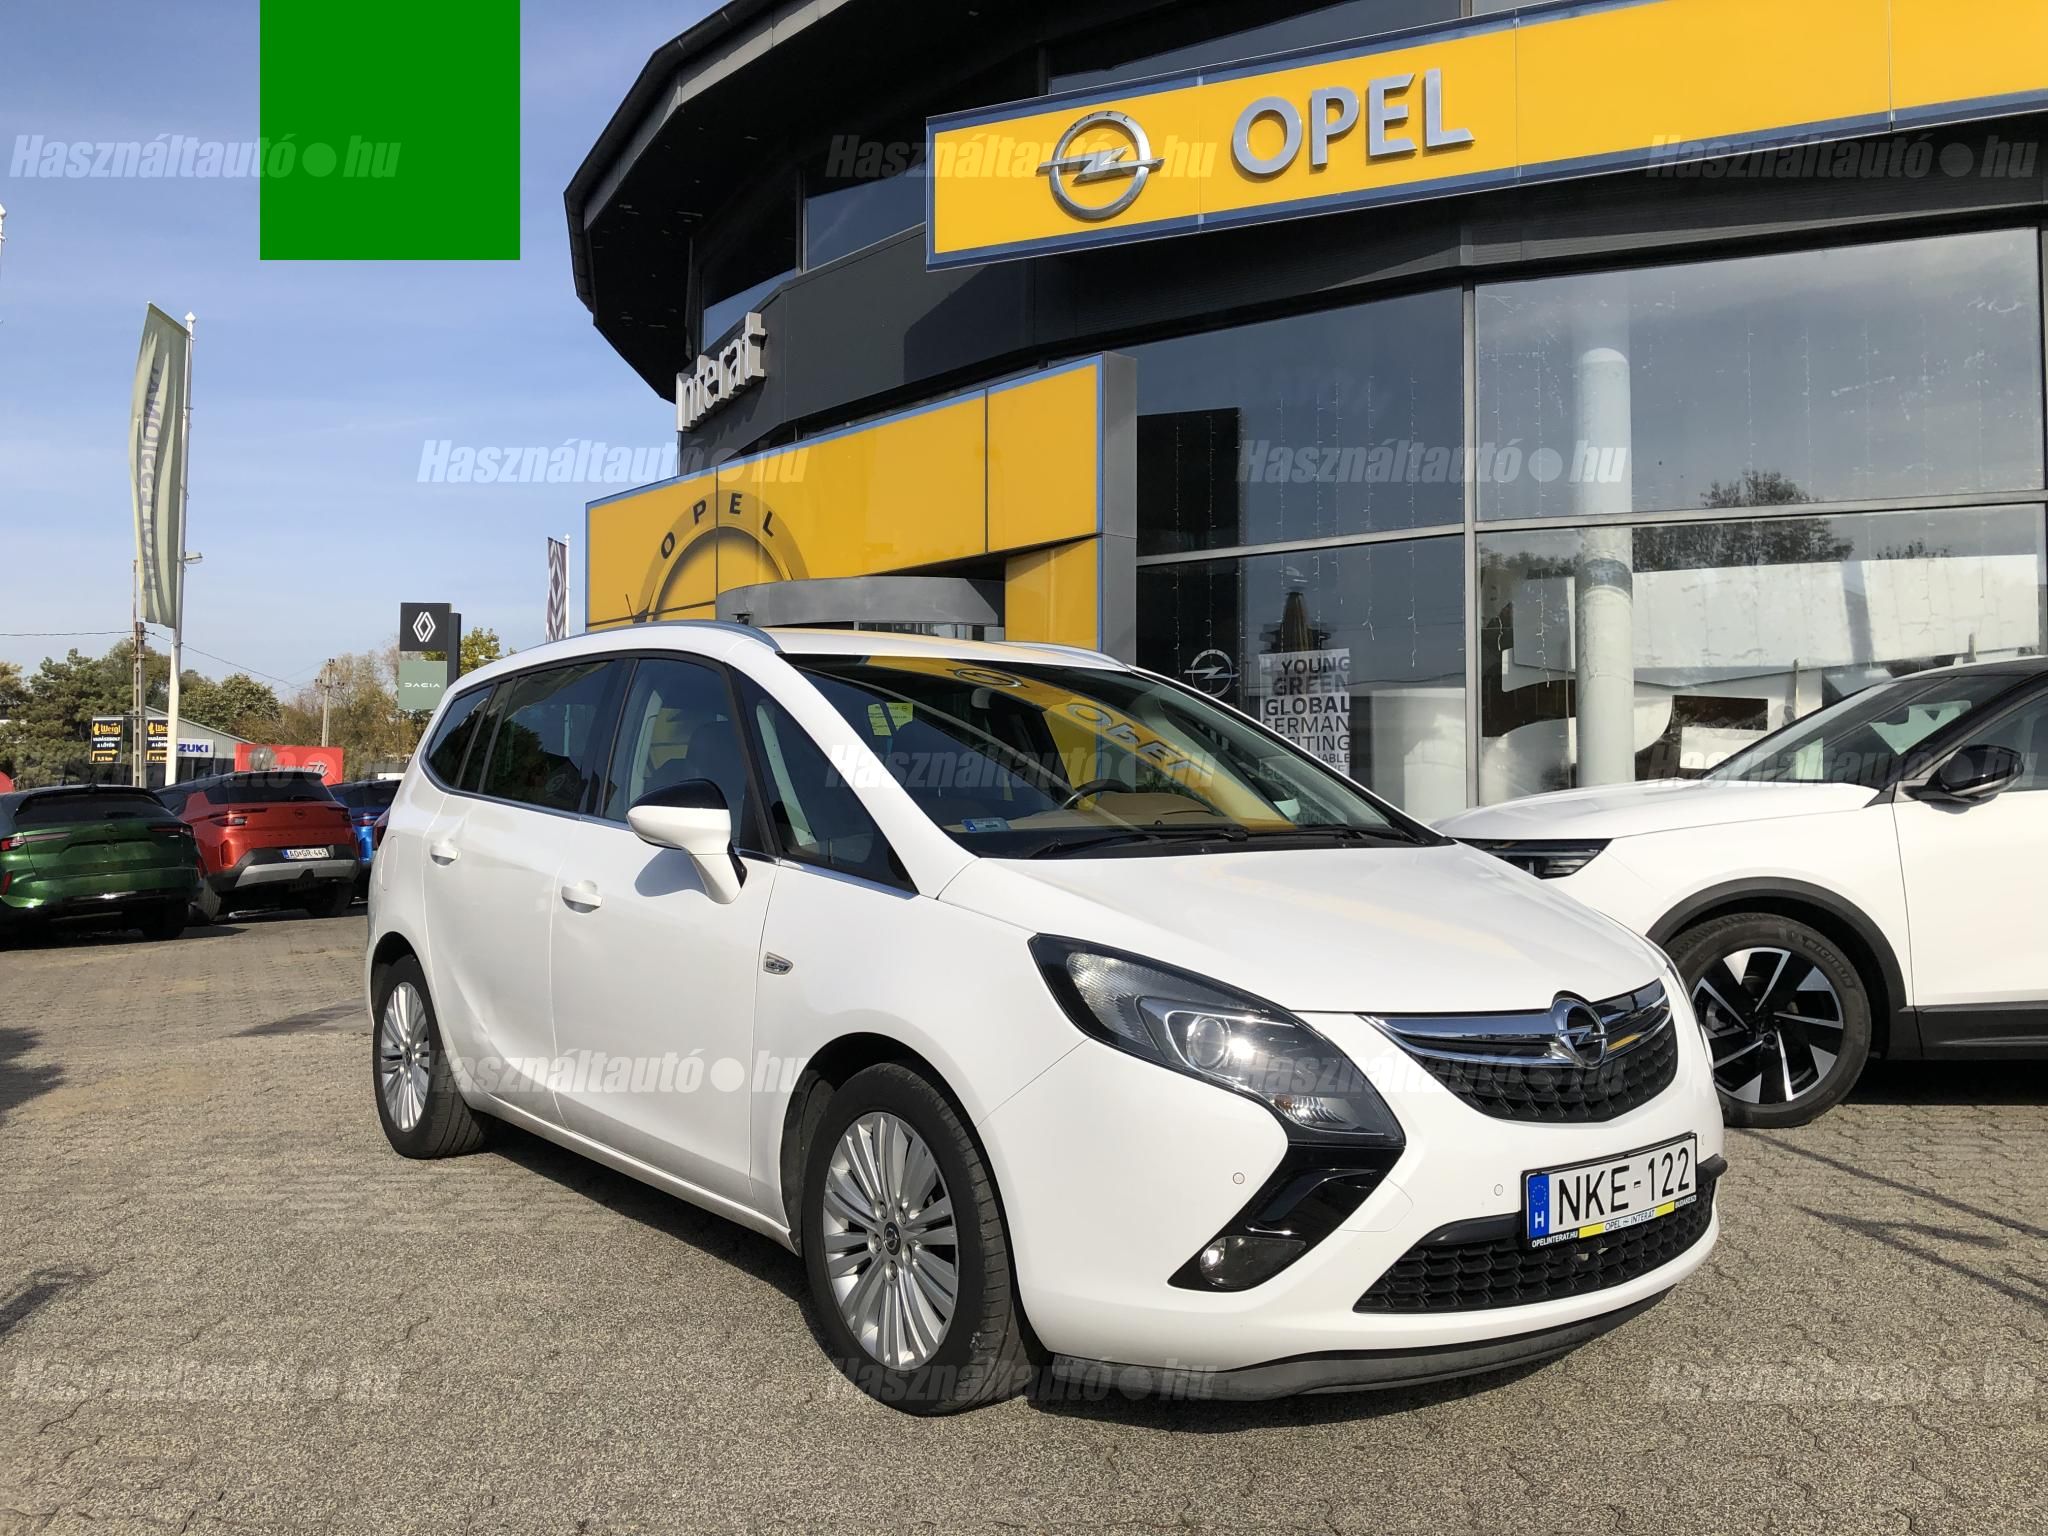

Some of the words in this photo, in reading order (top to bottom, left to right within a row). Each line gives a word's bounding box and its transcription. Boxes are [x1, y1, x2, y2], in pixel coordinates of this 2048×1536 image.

[1232, 68, 1475, 177] OPEL
[660, 493, 775, 560] OPEL
[1281, 656, 1349, 675] YOUNG
[1272, 674, 1349, 696] GREEN
[1266, 696, 1349, 715] GLOBAL
[178, 744, 209, 752] ZUKI
[1558, 1147, 1690, 1225] NKE-122
[1531, 1230, 1578, 1248] OPELINTERAT.HU
[1604, 1220, 1621, 1231] OPEL
[1630, 1209, 1656, 1224] INTERAT
[1534, 1211, 1545, 1228] H
